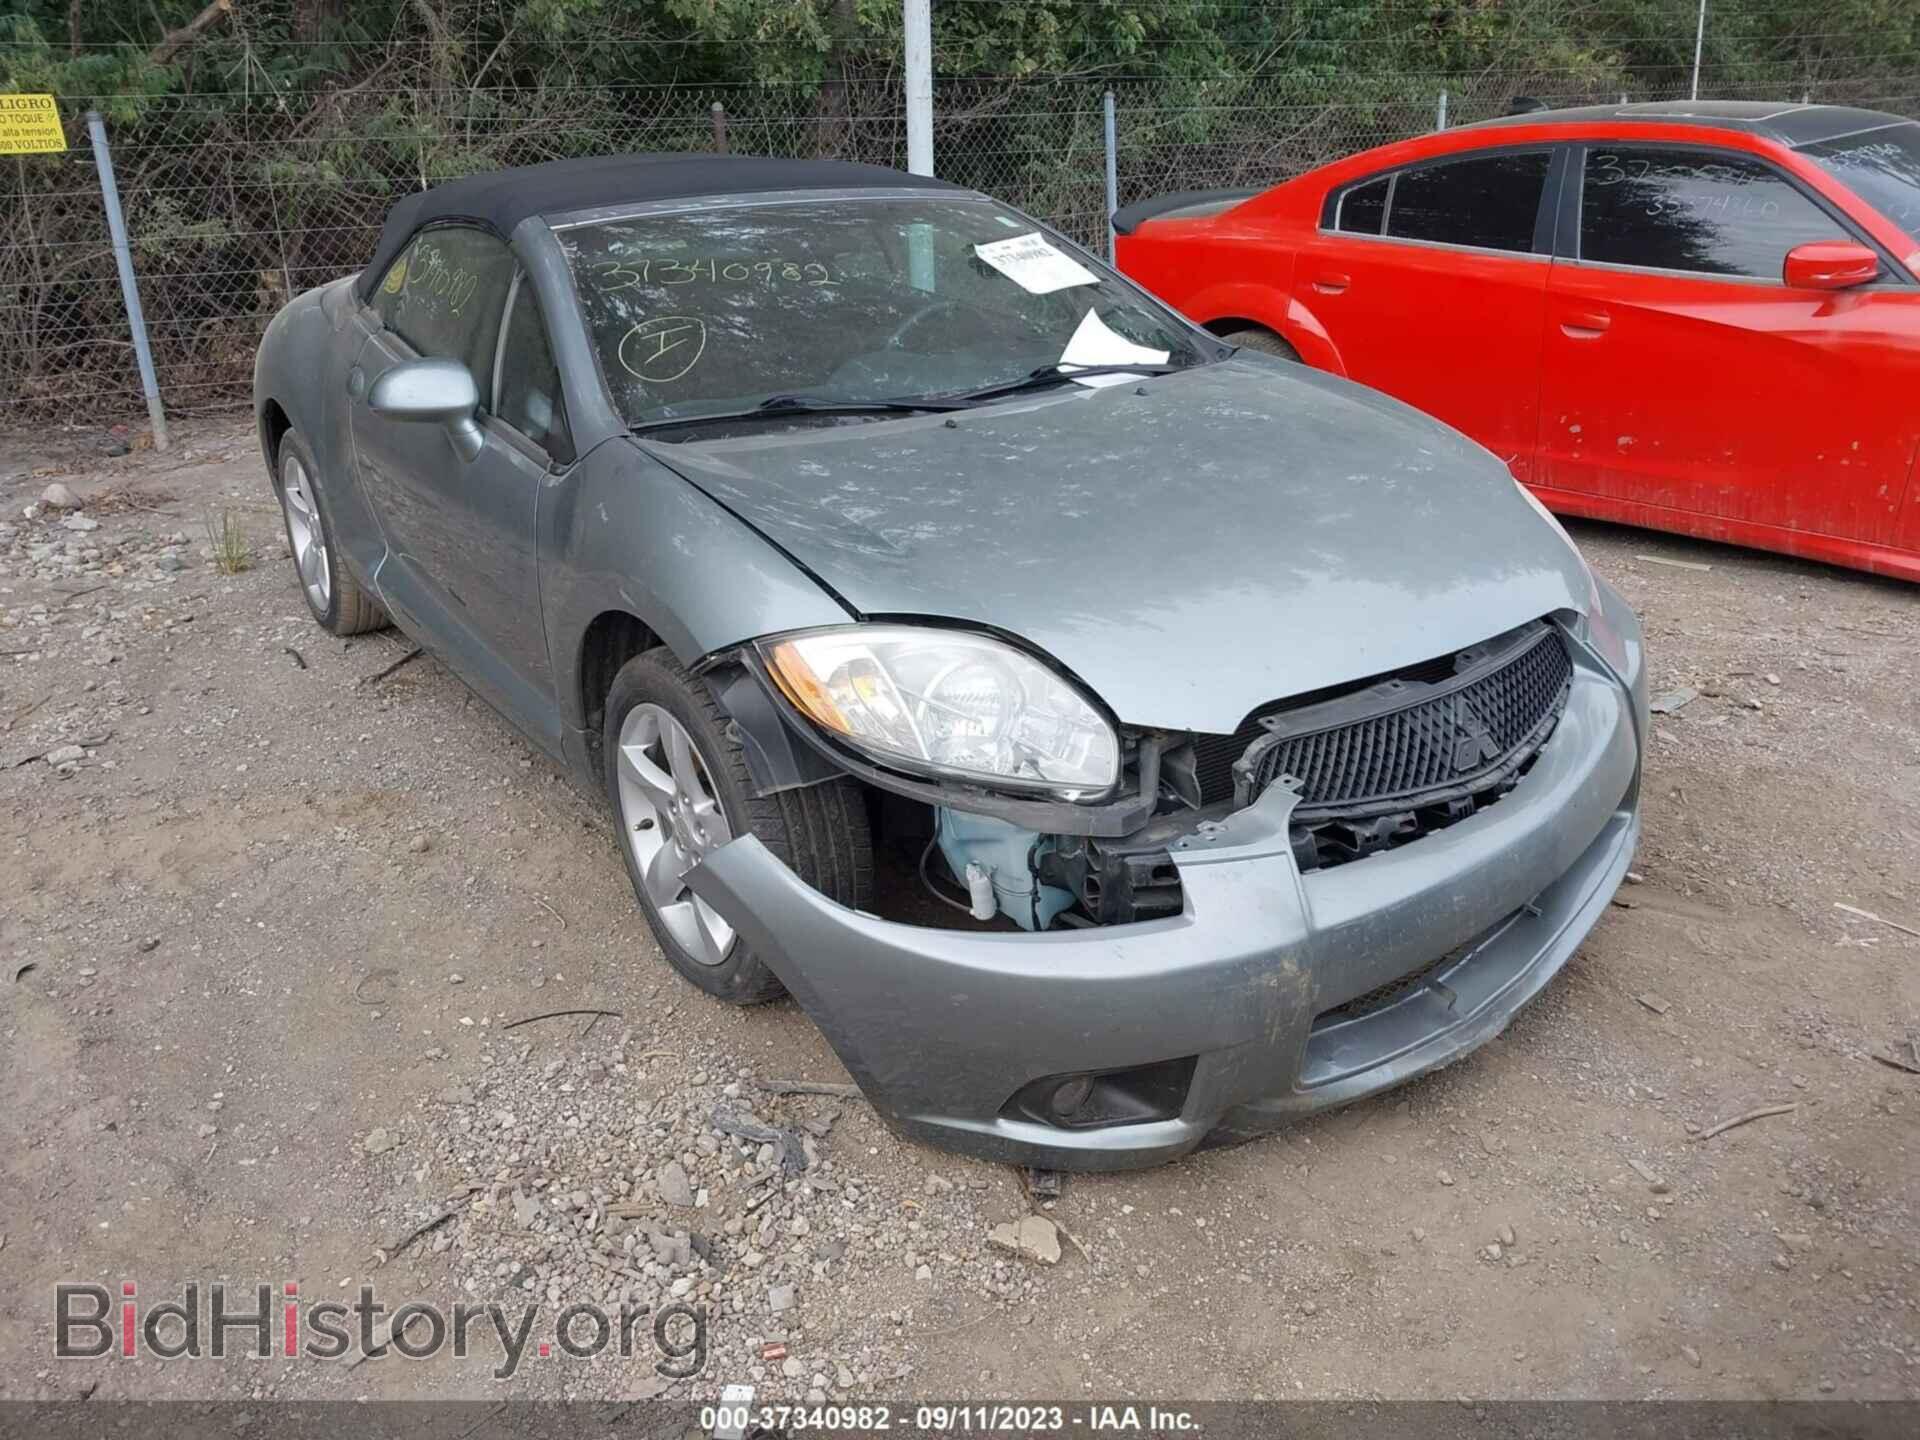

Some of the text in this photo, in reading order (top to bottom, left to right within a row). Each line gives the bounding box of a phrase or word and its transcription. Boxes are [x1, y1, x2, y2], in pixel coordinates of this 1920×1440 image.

[8, 113, 44, 124] TOQUE
[2, 128, 20, 137] alta
[14, 139, 63, 150] VOLTIOS
